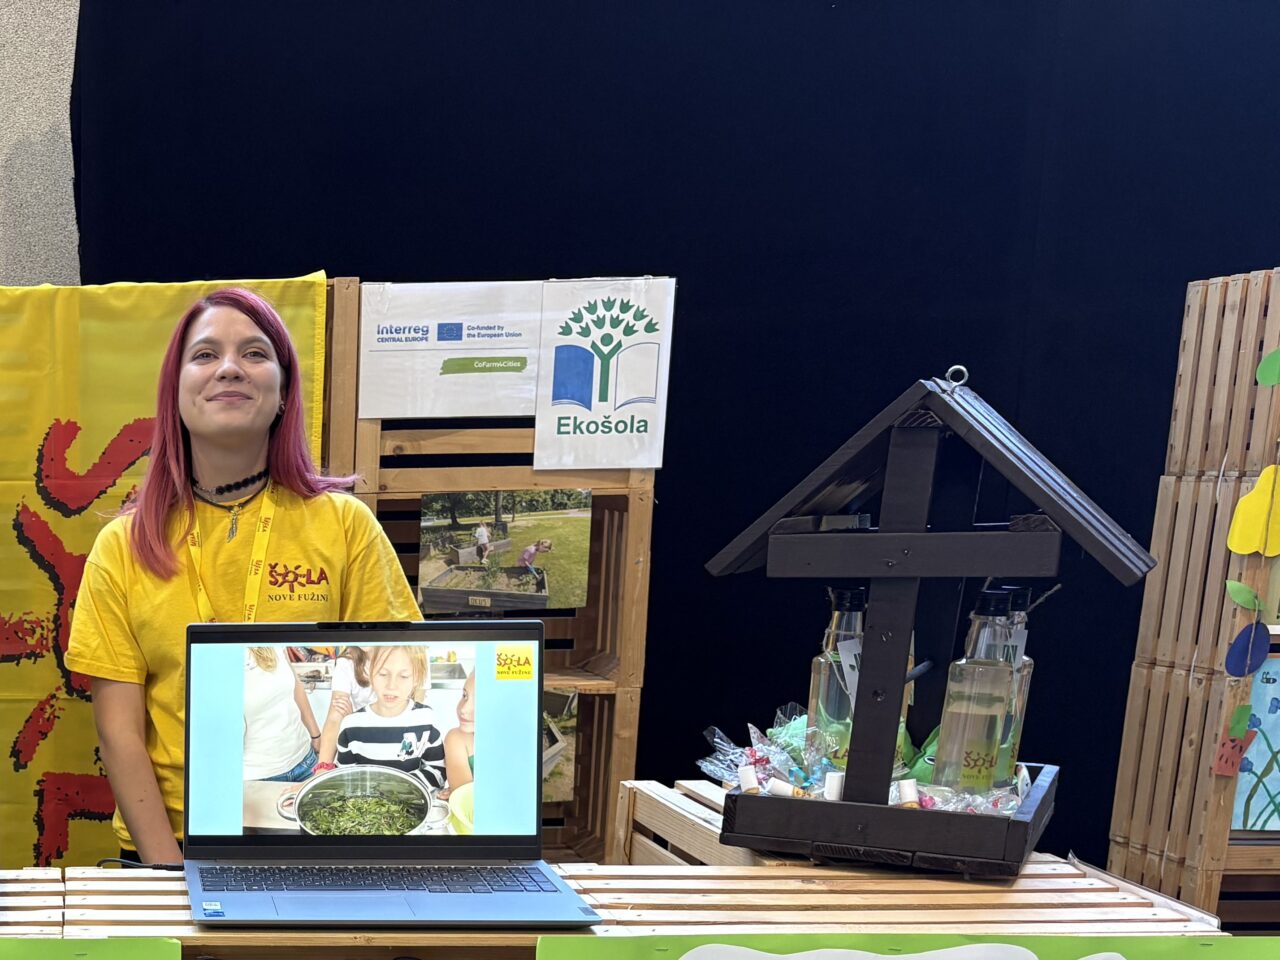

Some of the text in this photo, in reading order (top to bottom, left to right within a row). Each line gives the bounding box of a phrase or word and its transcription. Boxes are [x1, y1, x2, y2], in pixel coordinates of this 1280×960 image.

[377, 324, 429, 335] Interreg
[556, 415, 649, 435] Ekošola
[268, 563, 330, 593] ŠOLA
[268, 594, 295, 602] NOVE
